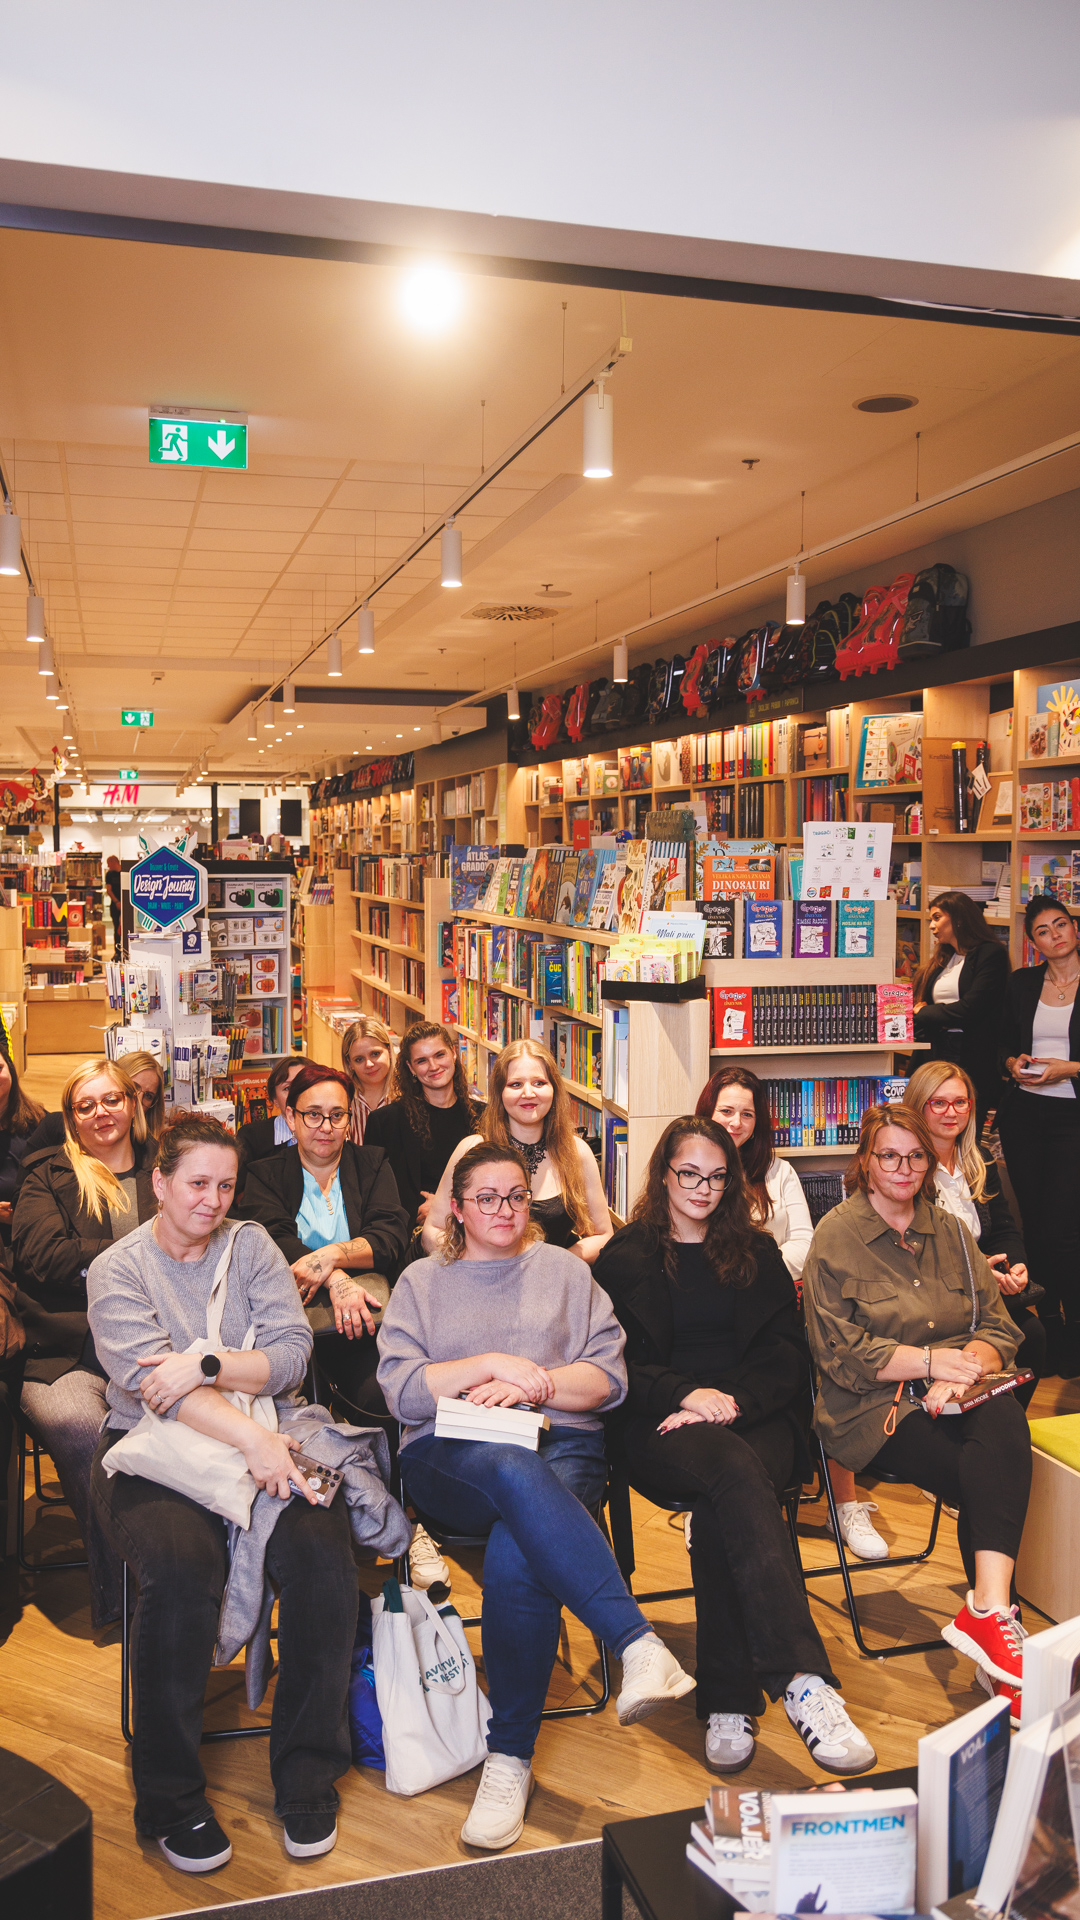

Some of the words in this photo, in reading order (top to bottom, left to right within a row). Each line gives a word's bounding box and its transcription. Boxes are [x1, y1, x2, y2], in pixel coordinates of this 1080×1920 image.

[103, 784, 140, 805] H&M
[461, 862, 486, 871] GRADO
[134, 875, 163, 900] Design
[162, 875, 196, 901] Journey
[712, 880, 770, 890] DINOSAURI
[751, 903, 778, 914] Gregov
[844, 904, 870, 914] Gregov
[656, 928, 675, 939] Mali
[719, 990, 747, 1001] Gregov
[883, 988, 908, 998] Gregov
[883, 1082, 905, 1098] ČOVP
[991, 1379, 1017, 1395] ZAVODNIK
[961, 1721, 1000, 1764] VOAJER
[739, 1791, 764, 1860] VOAJER
[791, 1814, 906, 1836] FRONTMEN
